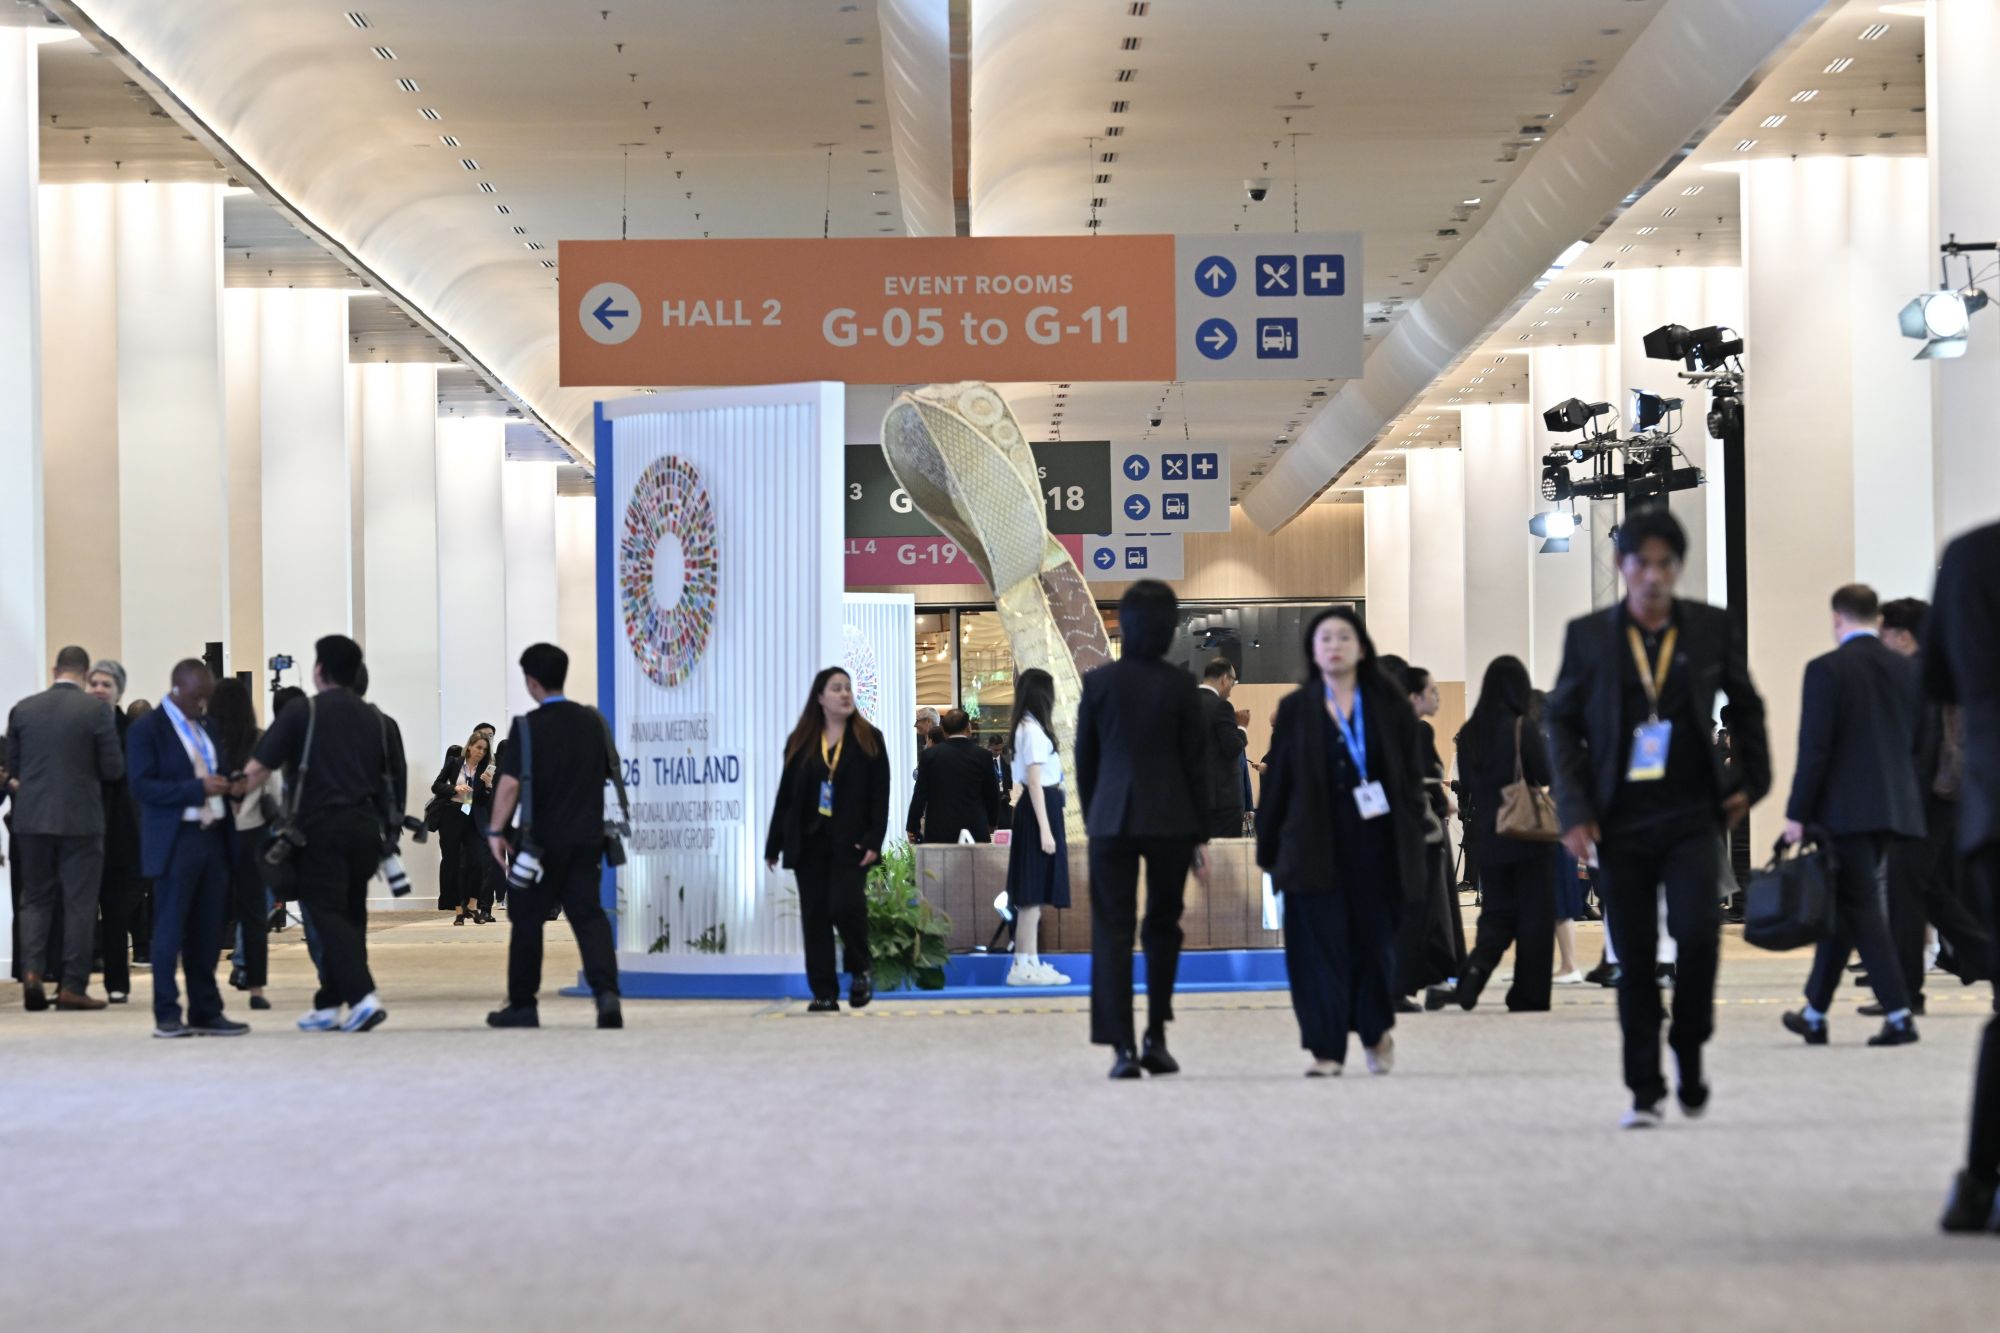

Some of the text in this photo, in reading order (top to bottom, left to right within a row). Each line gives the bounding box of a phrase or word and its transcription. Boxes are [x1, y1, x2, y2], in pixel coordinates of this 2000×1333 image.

[884, 275, 1073, 295] EVENT ROOMS
[662, 299, 782, 326] HALL 2
[822, 306, 1128, 347] G-05 to G-11
[849, 482, 863, 500] 3
[864, 539, 877, 554] 4
[897, 543, 958, 565] G-19
[631, 718, 709, 743] ANNUAL MEETINGS
[652, 754, 740, 787] THAILAND
[666, 800, 713, 823] MONETARY
[715, 799, 741, 821] FUND
[659, 828, 683, 850] BANK
[685, 827, 716, 850] GROUP
